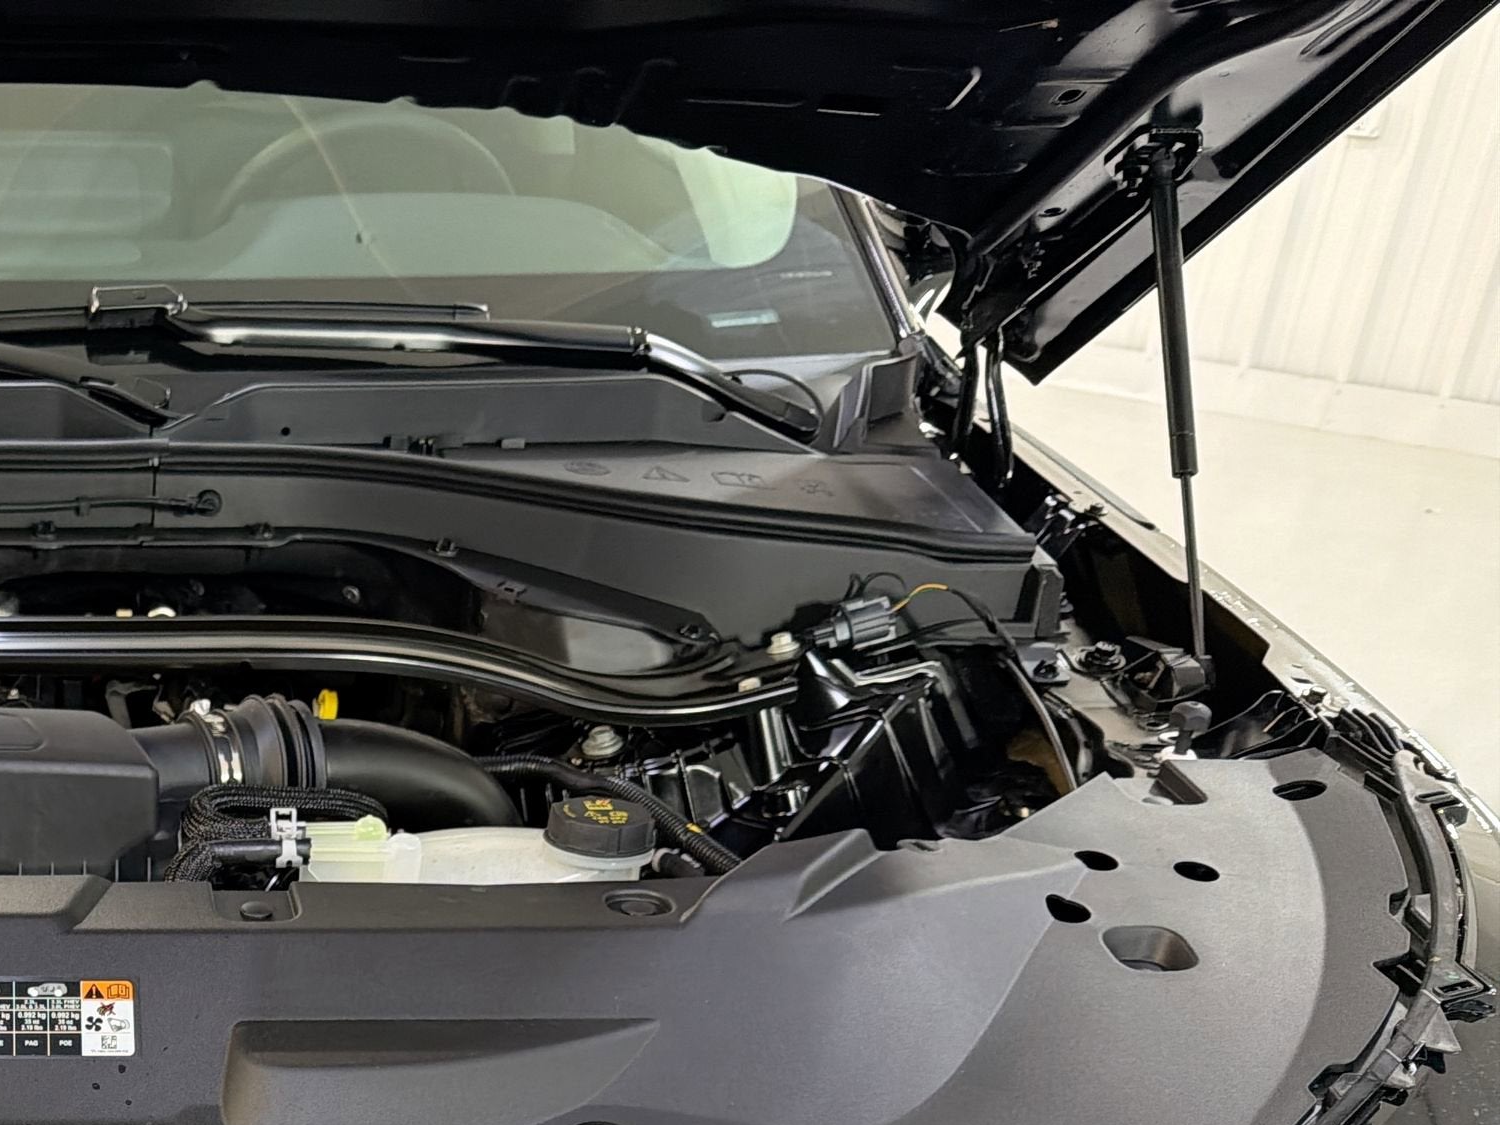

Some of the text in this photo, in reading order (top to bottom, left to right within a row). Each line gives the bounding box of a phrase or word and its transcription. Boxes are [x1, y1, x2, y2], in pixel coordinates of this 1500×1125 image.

[1, 1012, 10, 1020] kg
[37, 1012, 46, 1020] kg
[70, 1012, 80, 1020] kg
